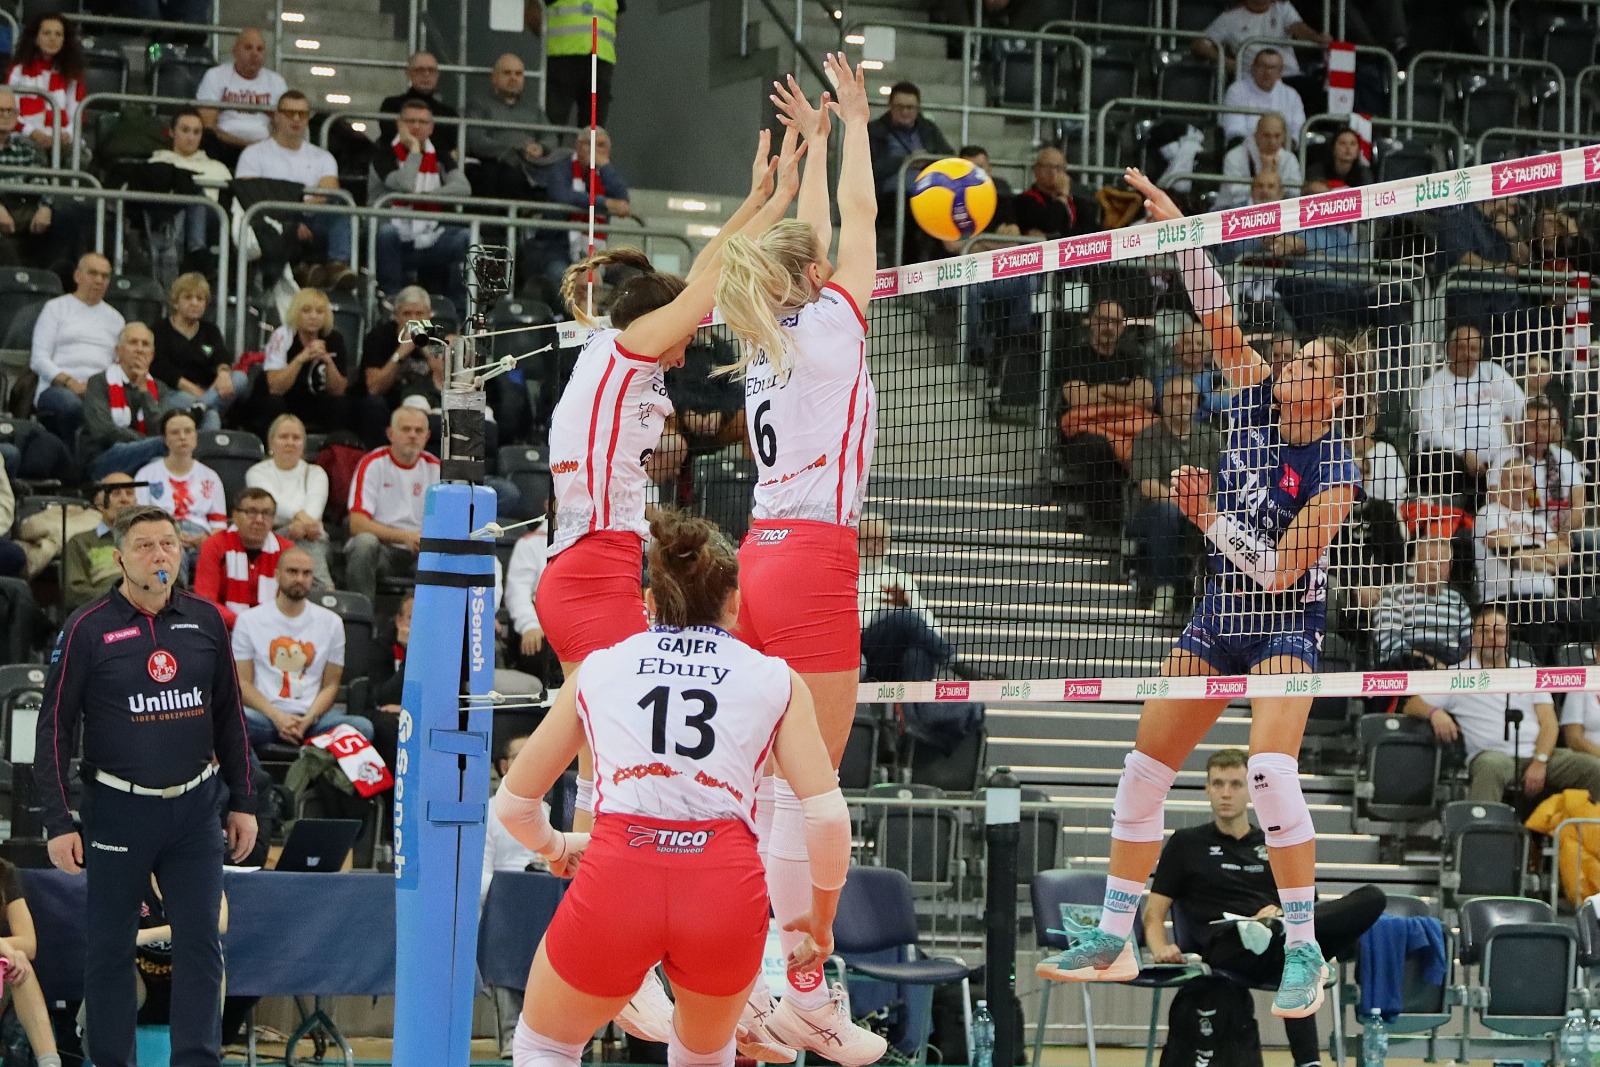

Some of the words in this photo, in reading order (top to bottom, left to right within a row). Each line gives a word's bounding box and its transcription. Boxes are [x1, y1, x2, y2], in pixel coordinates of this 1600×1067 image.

[1513, 163, 1557, 183] TAURON
[1319, 197, 1357, 215] TAURON
[1374, 190, 1396, 207] LIGA
[1415, 175, 1450, 207] plus
[1241, 211, 1276, 229] TAURON
[1076, 239, 1108, 256] TAURON
[1122, 234, 1141, 249] LIGA
[1157, 222, 1186, 249] plus
[1008, 251, 1039, 267] TAURON
[873, 274, 895, 289] URON
[907, 270, 924, 284] LIGA
[937, 261, 962, 286] plus
[754, 399, 778, 467] 6
[760, 529, 788, 541] TICO
[471, 597, 485, 672] Senoh
[657, 636, 718, 657] GAJER
[636, 657, 732, 686] Ebury
[1450, 672, 1475, 690] plus
[1552, 674, 1582, 686] TAURON
[877, 683, 895, 701] plus
[946, 687, 967, 697] TAURON
[1001, 681, 1020, 700] plus
[1076, 686, 1099, 695] TAURON
[1136, 680, 1157, 699] plus
[1219, 682, 1244, 693] TAURON
[1285, 676, 1309, 695] plus
[1377, 678, 1404, 690] TAURON
[128, 686, 203, 713] Unilink
[637, 685, 718, 760] 13
[395, 748, 408, 879] Senoh
[658, 829, 708, 847] TICO
[656, 845, 704, 854] sportswear
